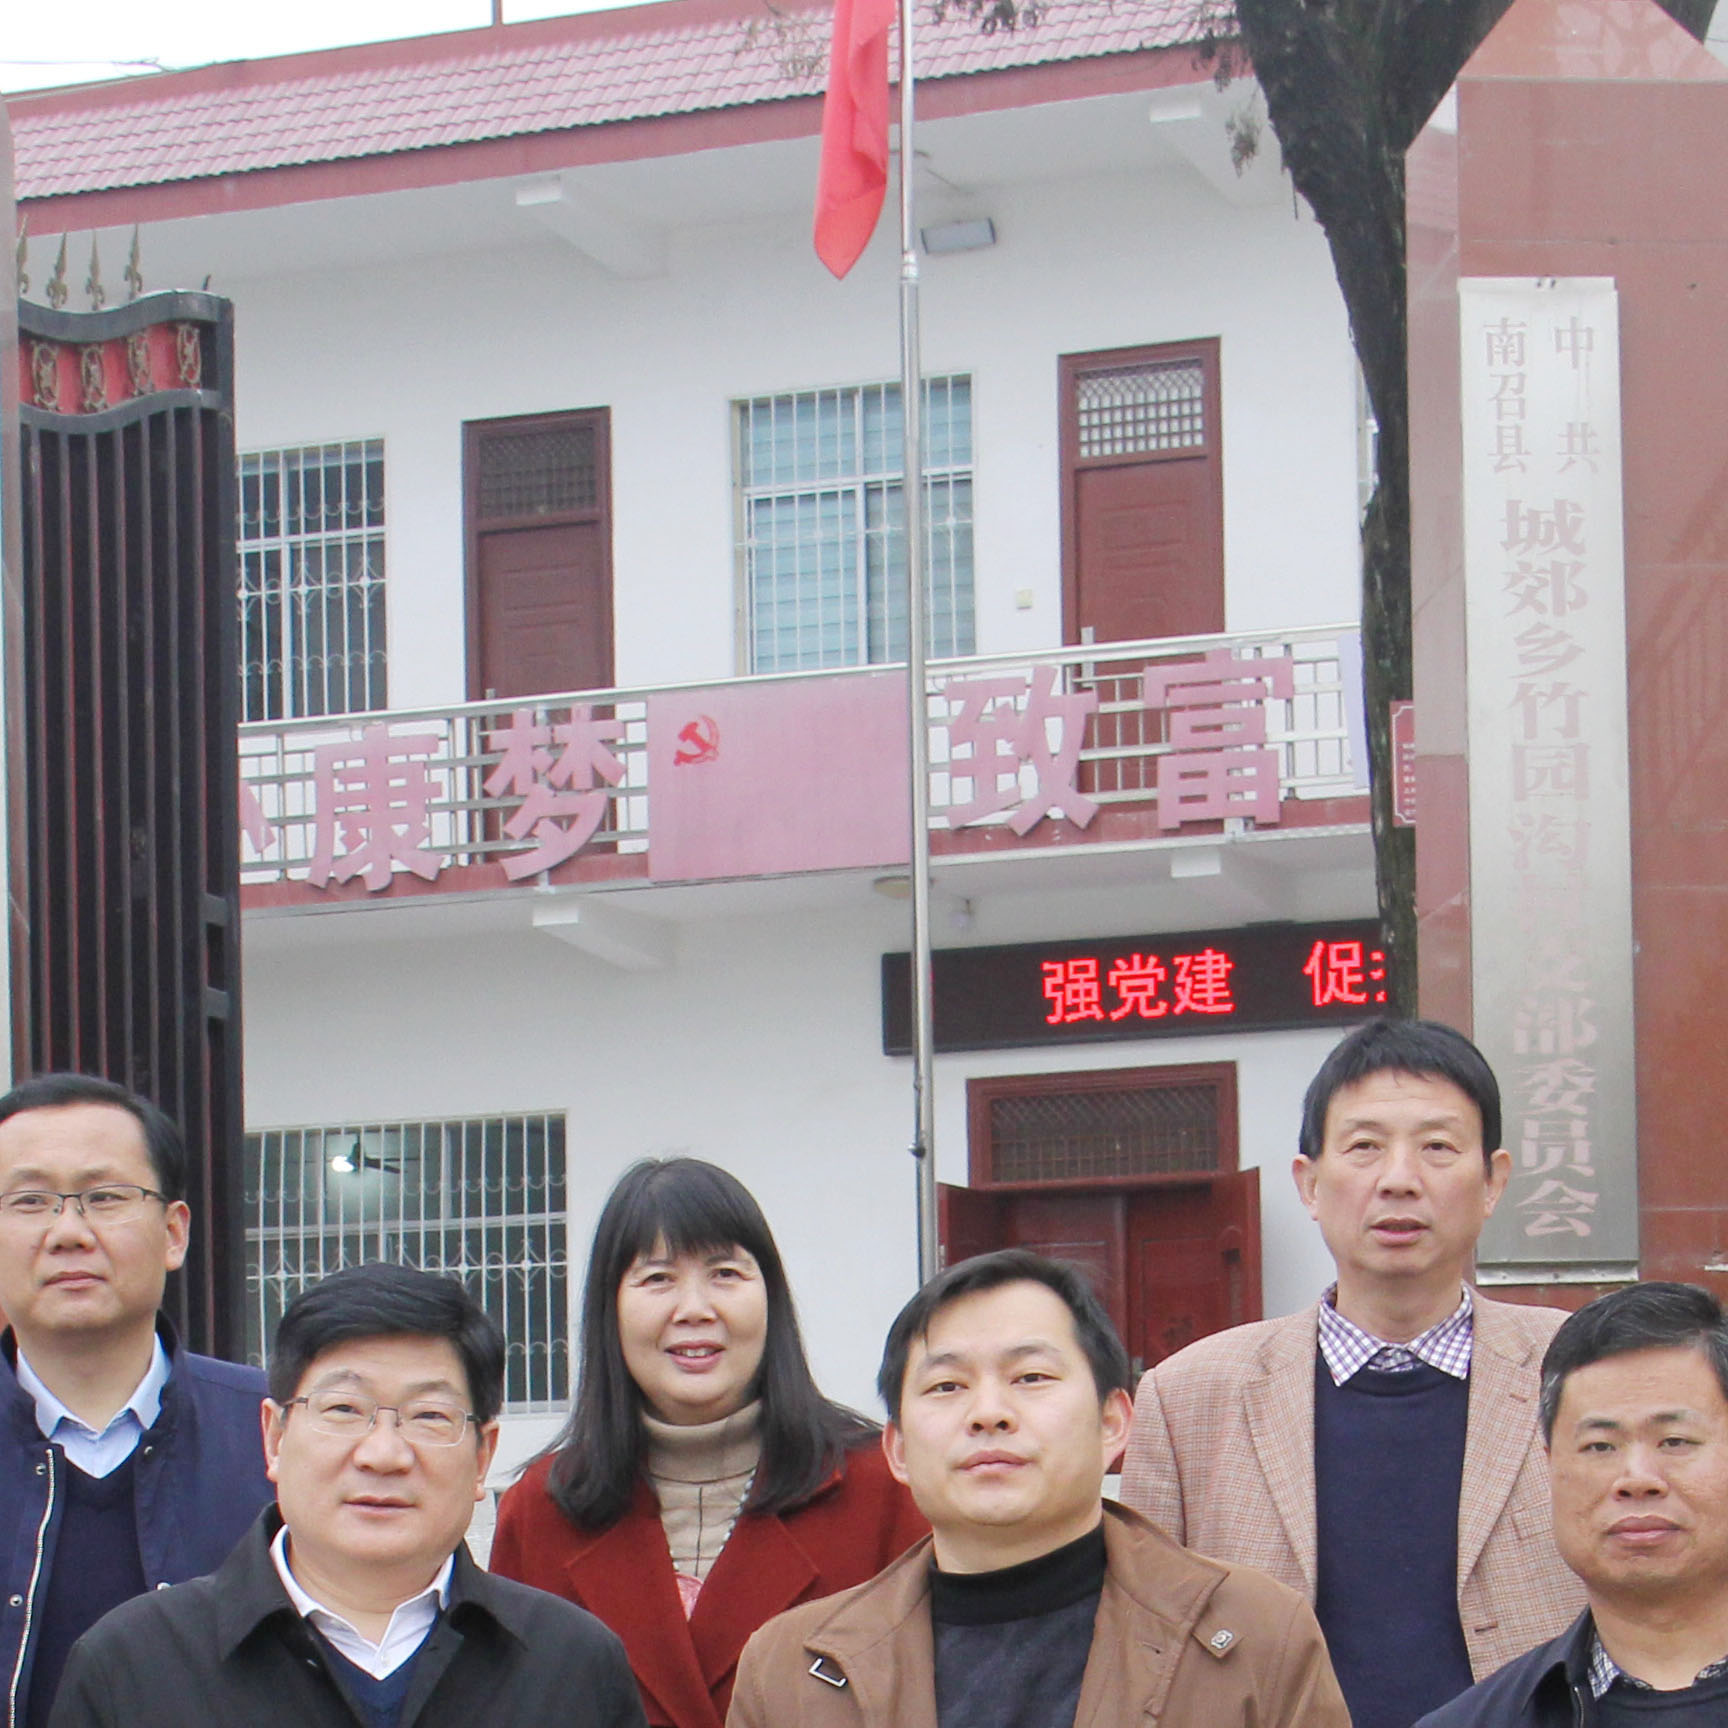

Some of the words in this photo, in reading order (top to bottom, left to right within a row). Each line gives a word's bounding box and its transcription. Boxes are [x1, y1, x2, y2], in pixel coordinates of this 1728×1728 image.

[1483, 317, 1532, 474] 南召县
[1555, 316, 1601, 474] 中共
[943, 648, 1294, 837] 致富
[1042, 948, 1236, 1025] 强党建
[1303, 939, 1386, 1007] 促
